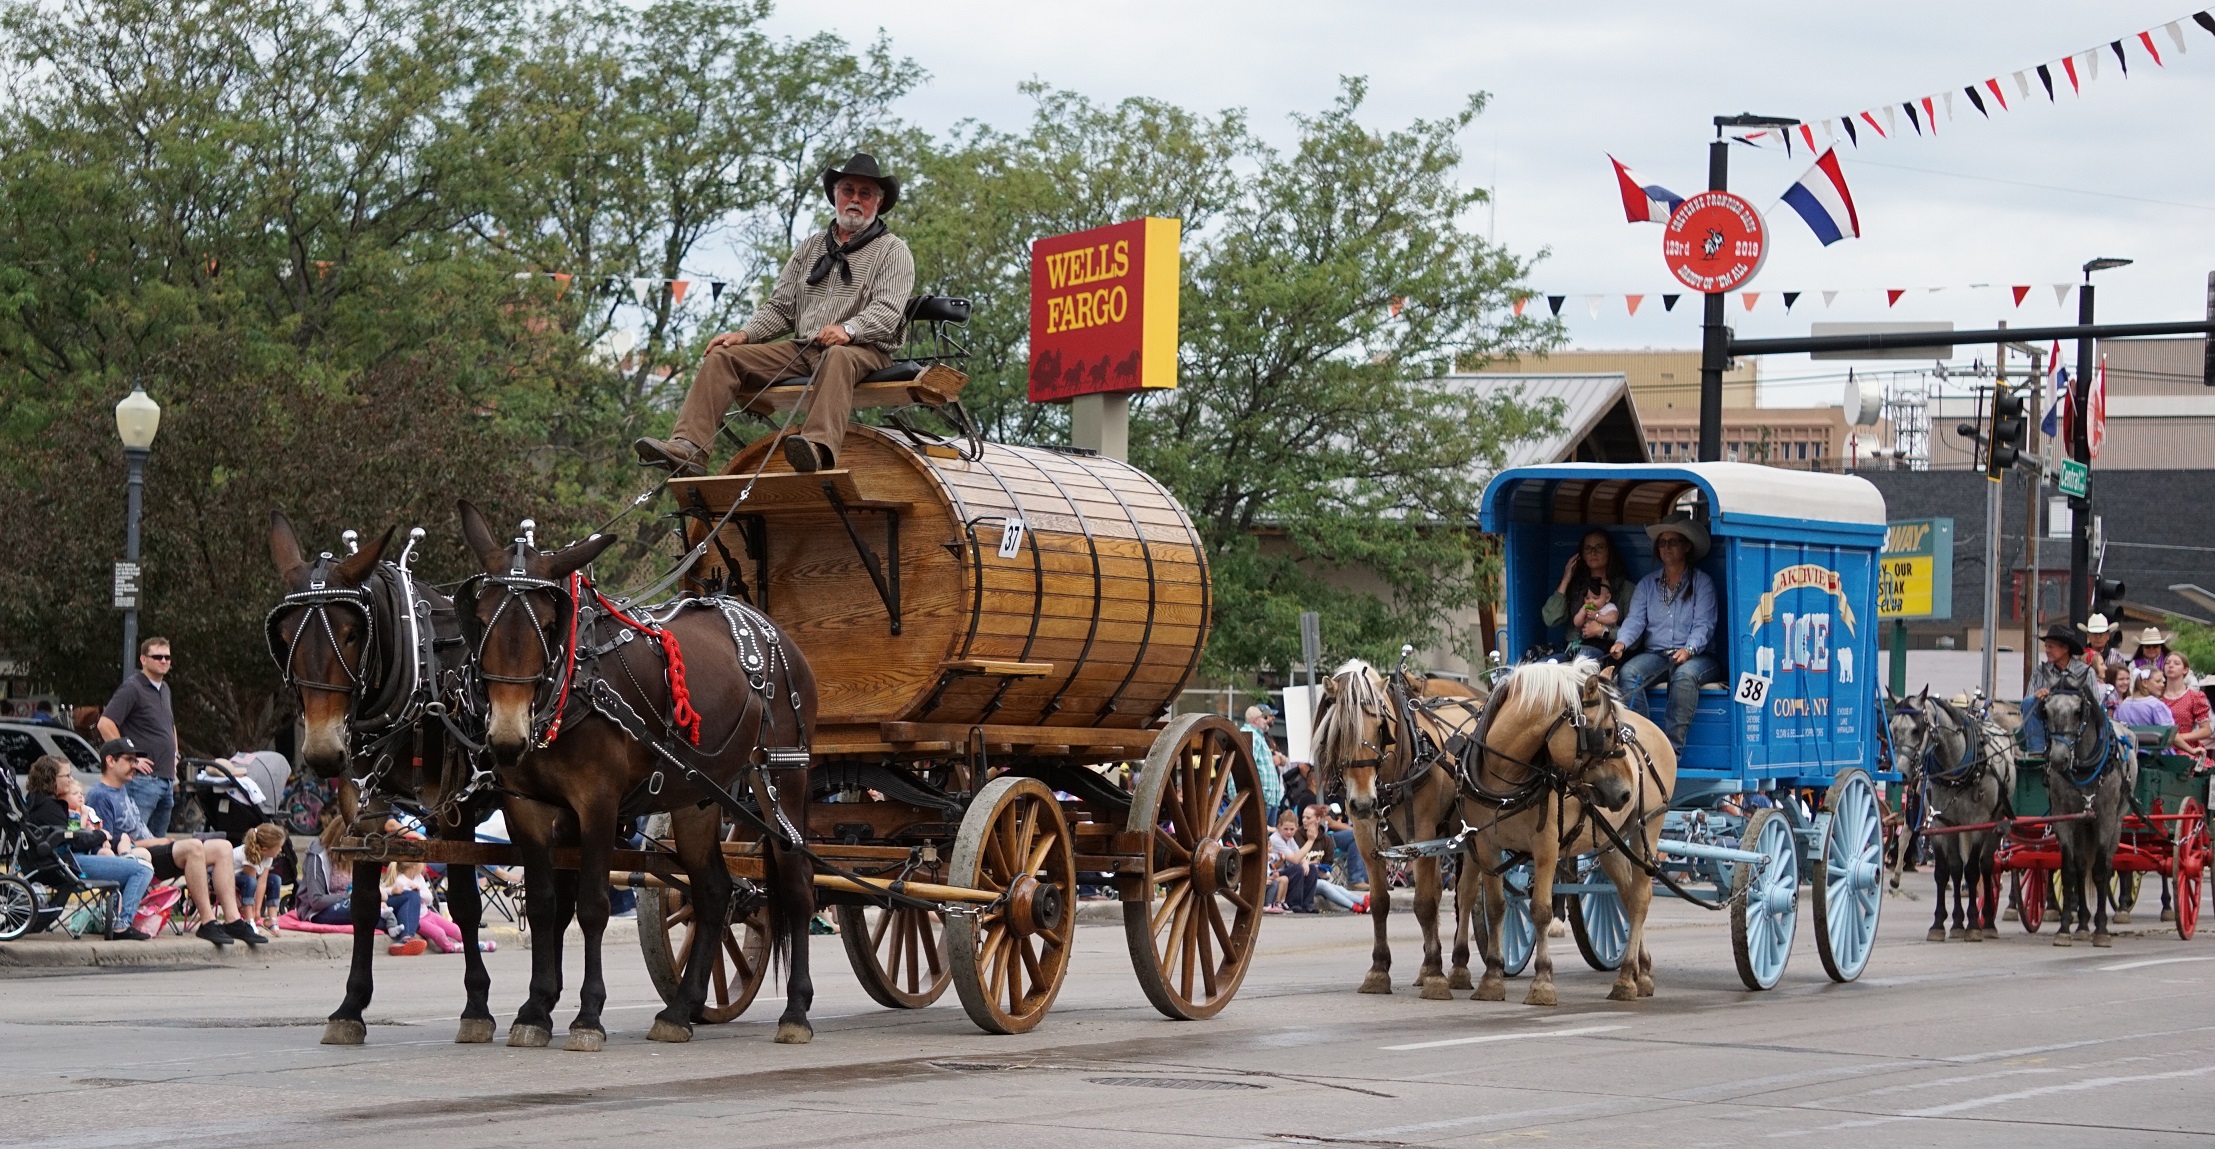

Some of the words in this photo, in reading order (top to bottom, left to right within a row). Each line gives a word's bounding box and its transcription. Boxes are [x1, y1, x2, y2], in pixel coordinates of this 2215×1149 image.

[1670, 196, 1705, 233] CHEYENNE
[1706, 194, 1745, 216] FRONTIER
[1740, 210, 1757, 233] DAYS
[1665, 240, 1690, 256] 123rd
[1735, 240, 1759, 257] 2019
[1045, 239, 1129, 290] WELLS
[1703, 276, 1714, 290] OF
[1731, 262, 1749, 281] ALL
[1046, 285, 1128, 335] FARGO
[2061, 463, 2080, 490] Central
[1004, 525, 1020, 551] 37
[1894, 562, 1912, 577] OUR
[1881, 598, 1903, 613] CLUB
[1781, 611, 1830, 673] ICE
[1741, 678, 1763, 701] 38
